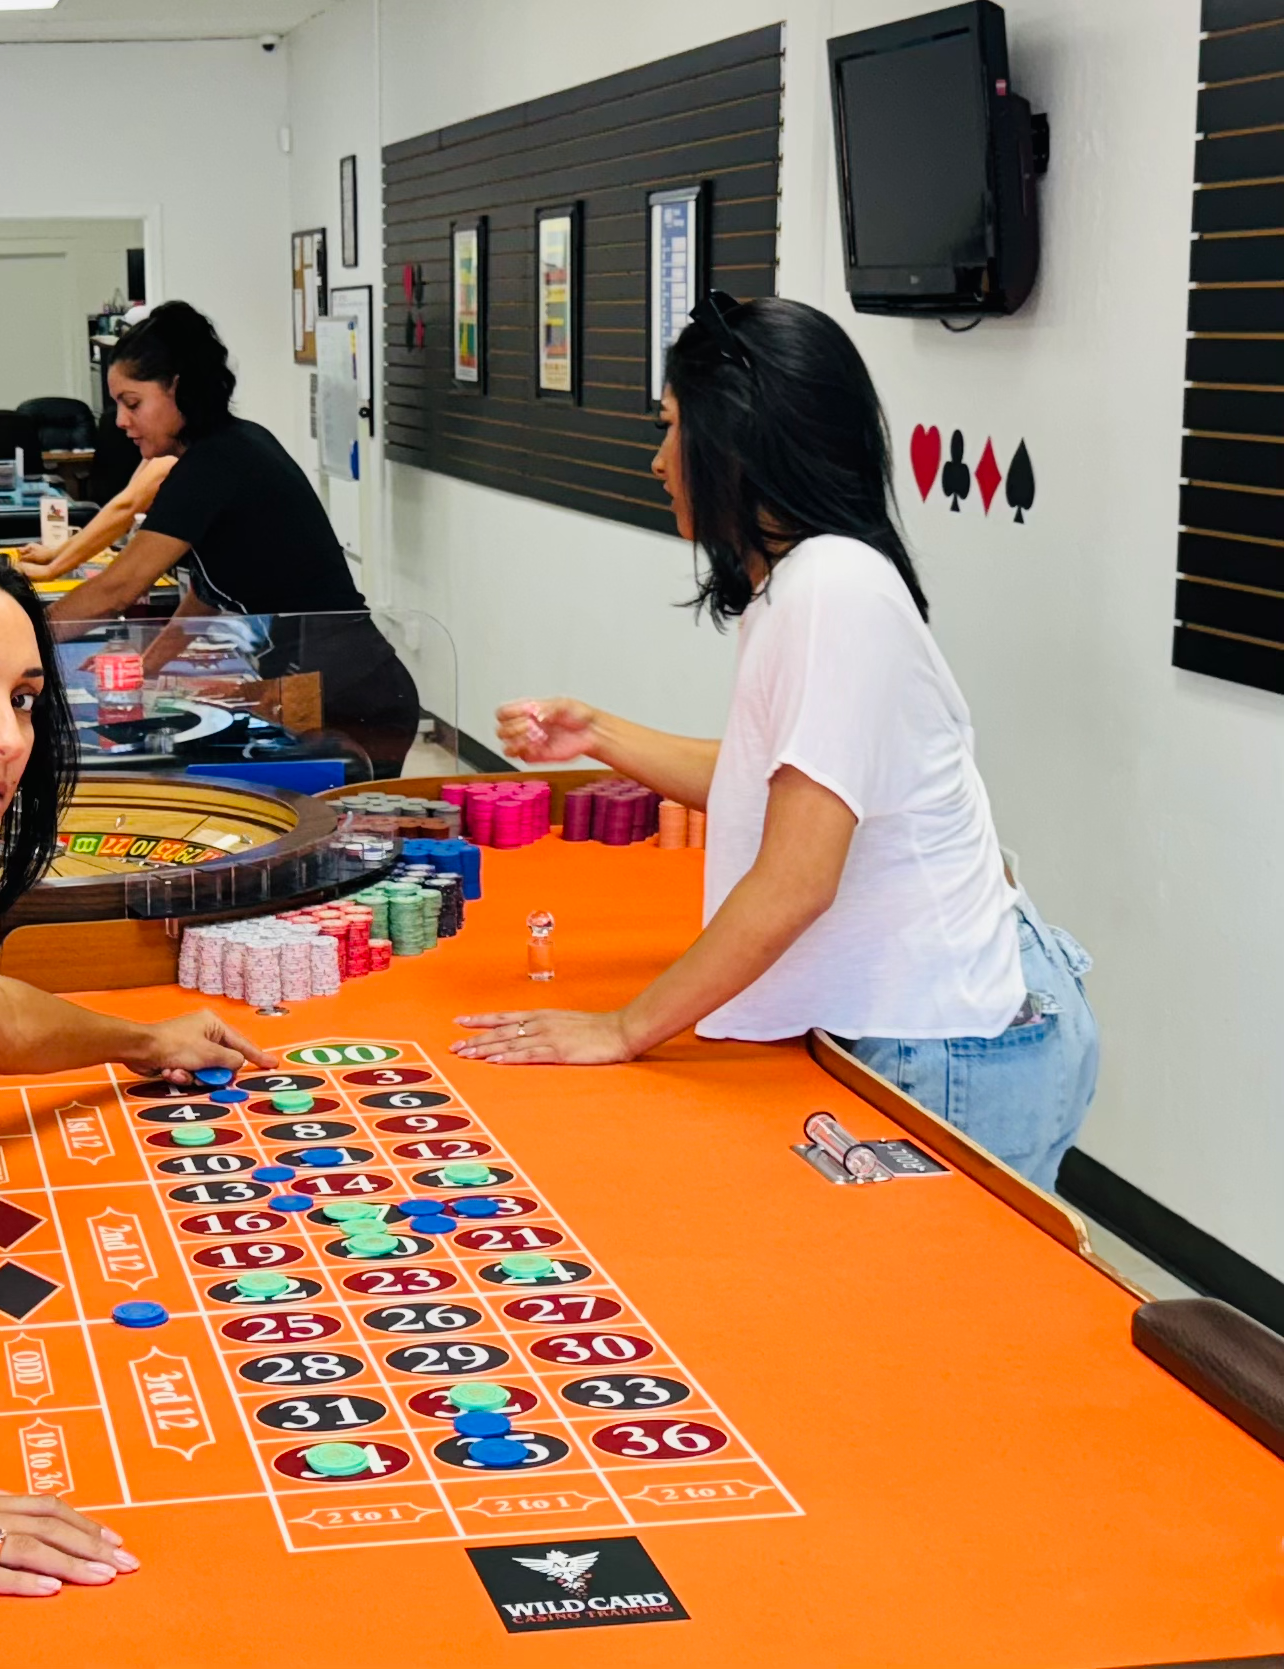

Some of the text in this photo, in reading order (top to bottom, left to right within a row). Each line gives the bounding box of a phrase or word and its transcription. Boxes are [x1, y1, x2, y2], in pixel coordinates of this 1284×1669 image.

[129, 840, 156, 855] 10
[300, 1043, 387, 1065] 00
[264, 1075, 297, 1092] 2
[374, 1069, 403, 1085] 3
[388, 1092, 422, 1108] 6
[168, 1104, 201, 1121] 4
[404, 1115, 439, 1132] 9
[65, 1116, 104, 1149] 1st 12
[291, 1122, 327, 1139] 8
[408, 1140, 479, 1160] 12
[172, 1154, 242, 1174] 10
[184, 1182, 256, 1203] 13
[306, 1174, 378, 1195] 14
[196, 1212, 272, 1235] 16
[330, 1204, 391, 1226] 7
[98, 1224, 146, 1271] 2nd 12
[470, 1226, 550, 1251] 21
[210, 1243, 286, 1267] 19
[360, 1268, 441, 1294] 23
[380, 1304, 467, 1332] 26
[519, 1295, 597, 1324] 27
[240, 1314, 325, 1341] 25
[403, 1343, 491, 1373] 29
[548, 1335, 637, 1363] 30
[12, 1350, 45, 1385] ODD
[256, 1353, 348, 1383] 28
[143, 1370, 200, 1430] 3rd 12
[579, 1376, 671, 1408] 33
[278, 1396, 369, 1429] 31
[612, 1422, 712, 1457] 36
[25, 1431, 66, 1491] 19 to 36
[661, 1482, 737, 1500] 2 to 1
[496, 1494, 570, 1513] 2 to 1
[327, 1508, 403, 1525] 2 to 1
[501, 1593, 669, 1617] WILD CARD
[512, 1604, 674, 1625] CASINO TRAINING
